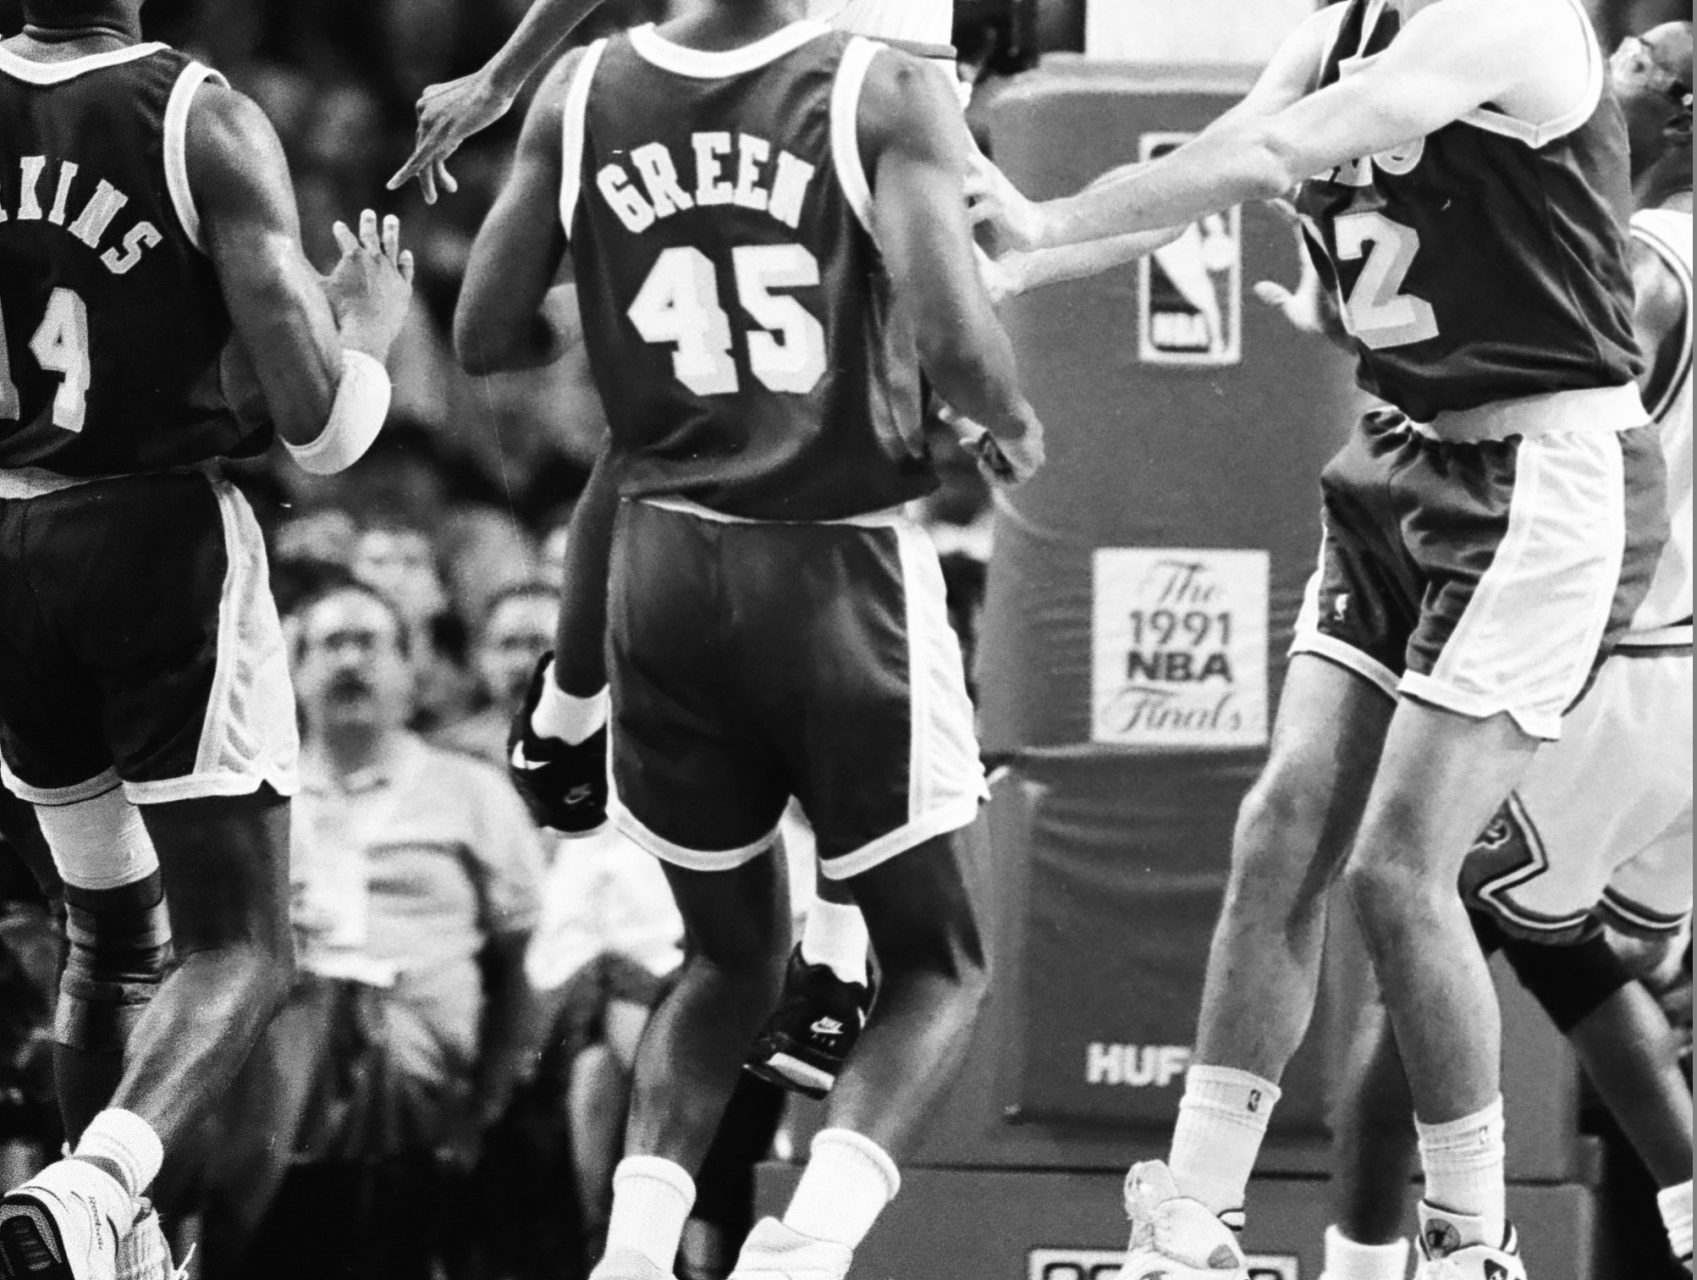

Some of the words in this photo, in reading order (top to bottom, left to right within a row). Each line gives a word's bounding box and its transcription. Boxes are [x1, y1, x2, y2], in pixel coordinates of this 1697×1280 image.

[596, 131, 816, 234] GREEN
[0, 155, 163, 274] KINS
[627, 242, 828, 396] 45
[1141, 558, 1221, 604] The
[1129, 608, 1232, 646] 1991
[1127, 650, 1234, 683] NBA
[1109, 686, 1242, 734] Finals
[1086, 1042, 1192, 1087] HUF
